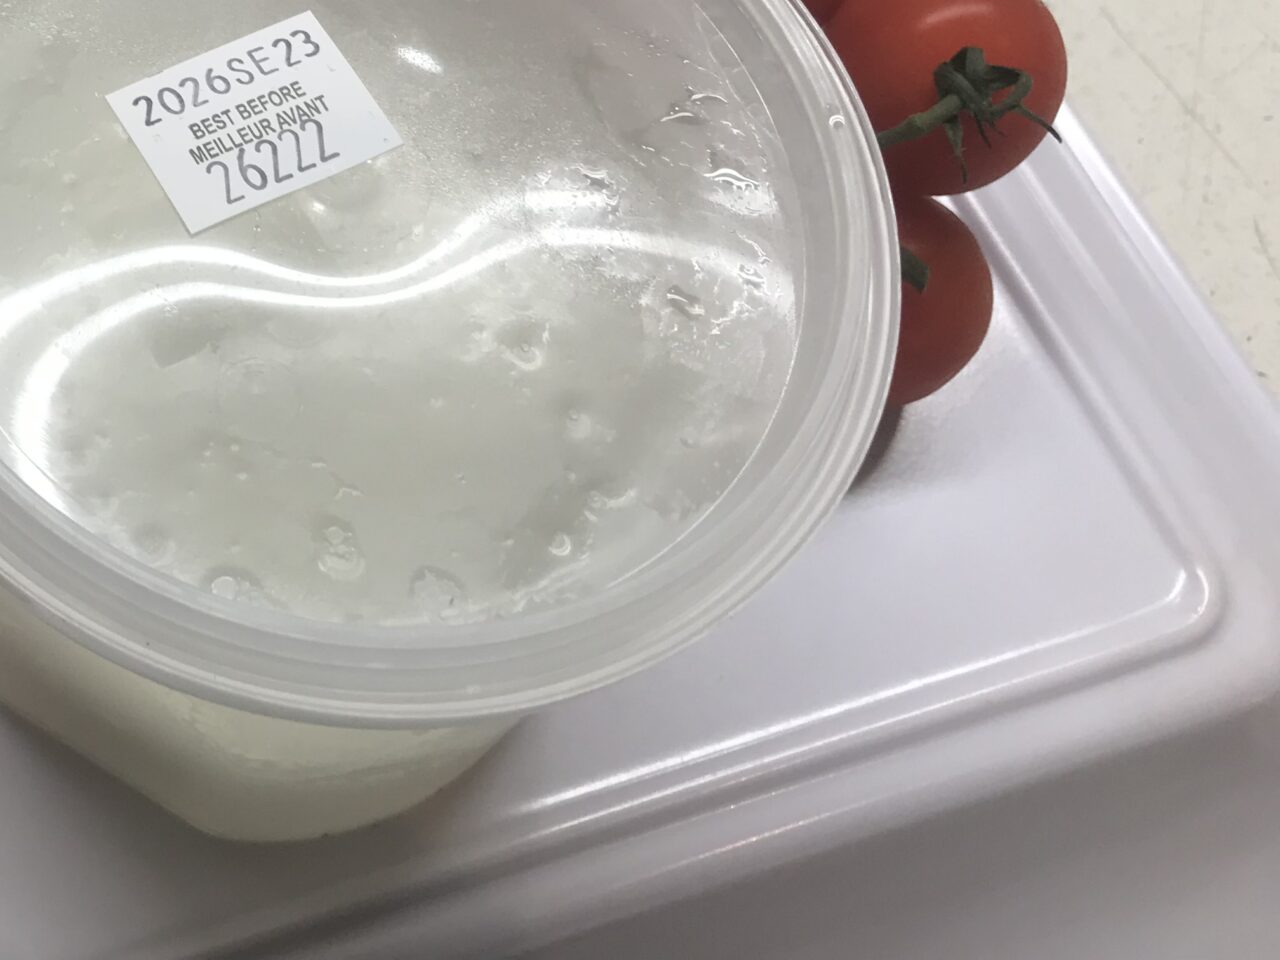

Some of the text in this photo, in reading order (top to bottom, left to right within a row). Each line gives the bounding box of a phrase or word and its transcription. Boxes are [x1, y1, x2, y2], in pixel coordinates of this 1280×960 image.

[131, 29, 320, 127] 2026SE23
[188, 80, 307, 140] BEST BEFORE
[188, 95, 330, 165] MEILLEUR AVANT
[205, 118, 341, 205] 26222
